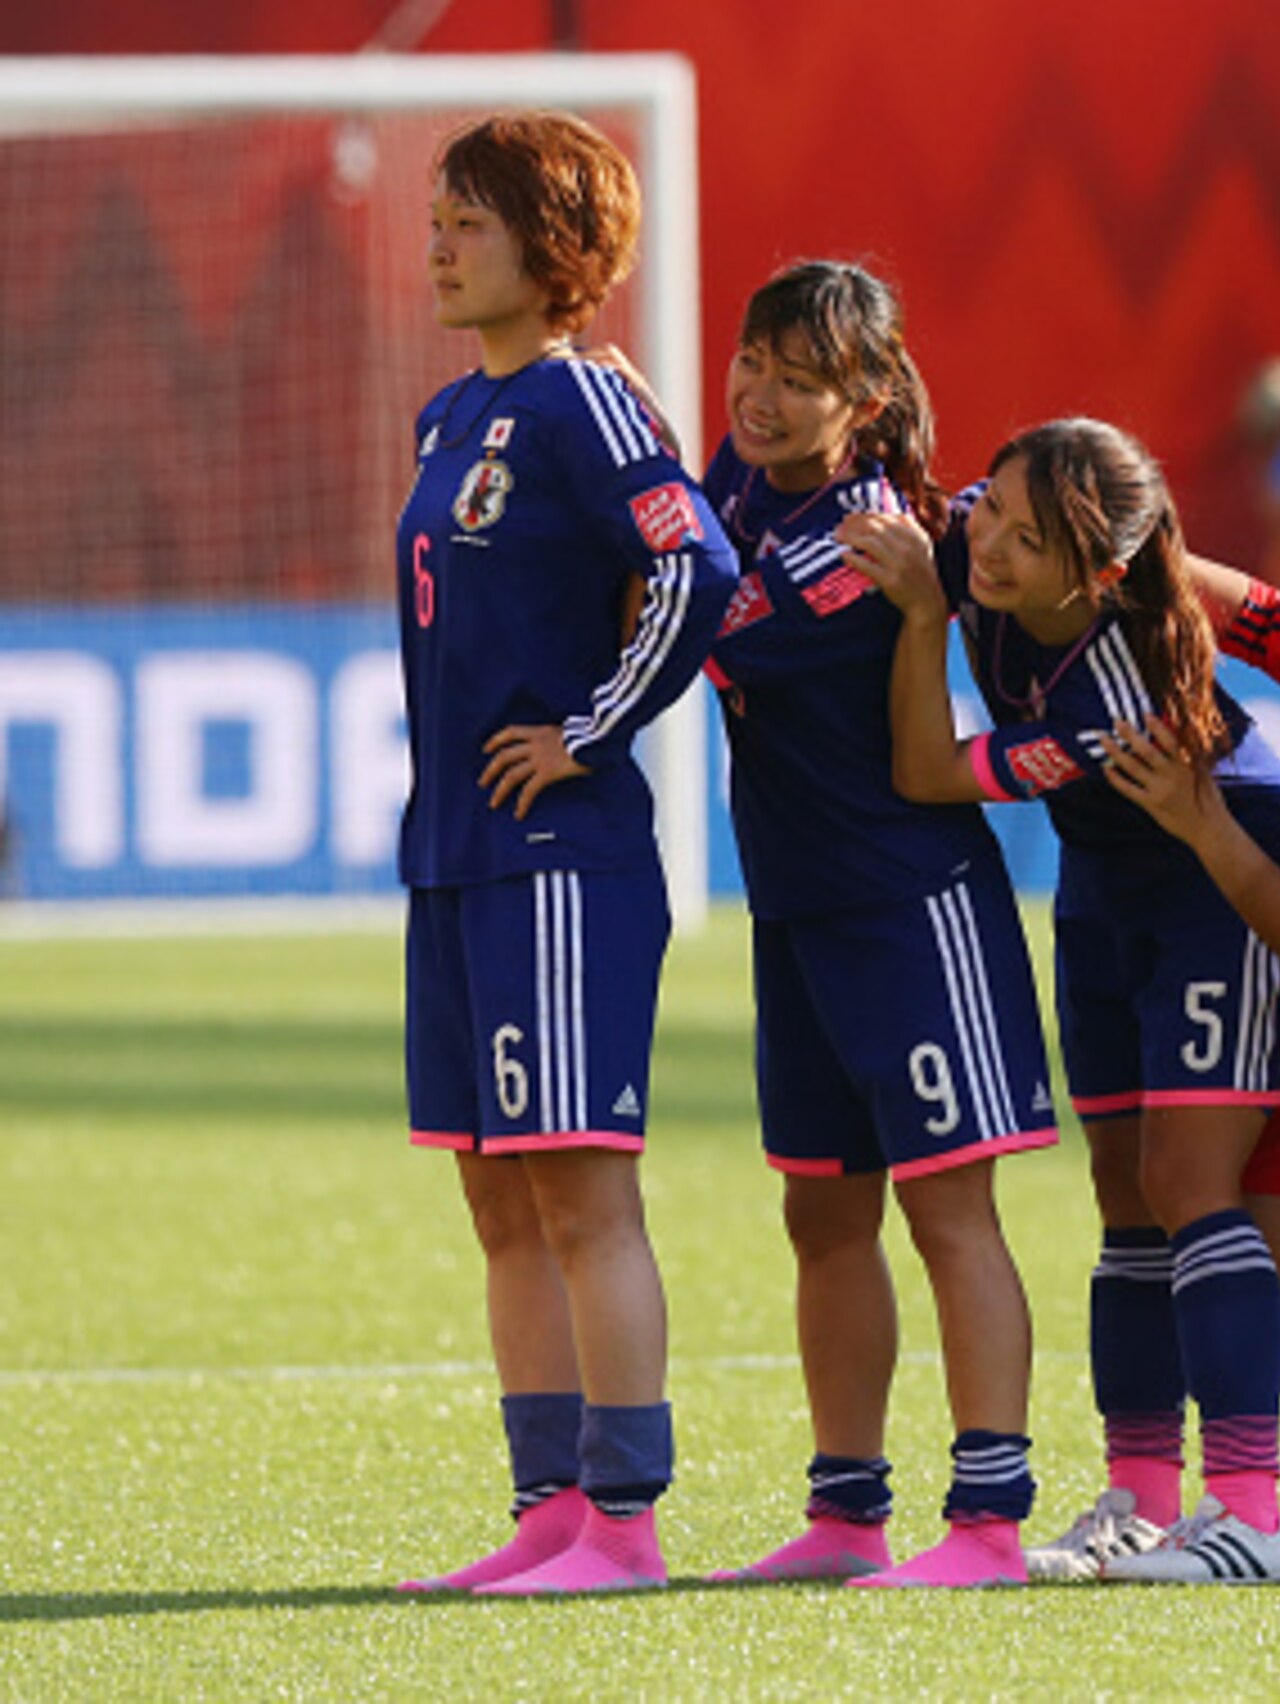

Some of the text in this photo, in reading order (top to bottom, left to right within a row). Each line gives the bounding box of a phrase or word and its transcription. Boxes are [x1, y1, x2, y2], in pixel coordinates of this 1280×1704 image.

[414, 533, 434, 627] 6
[493, 1024, 528, 1118] 6
[1181, 982, 1227, 1072] 5
[909, 1043, 961, 1135] 9
